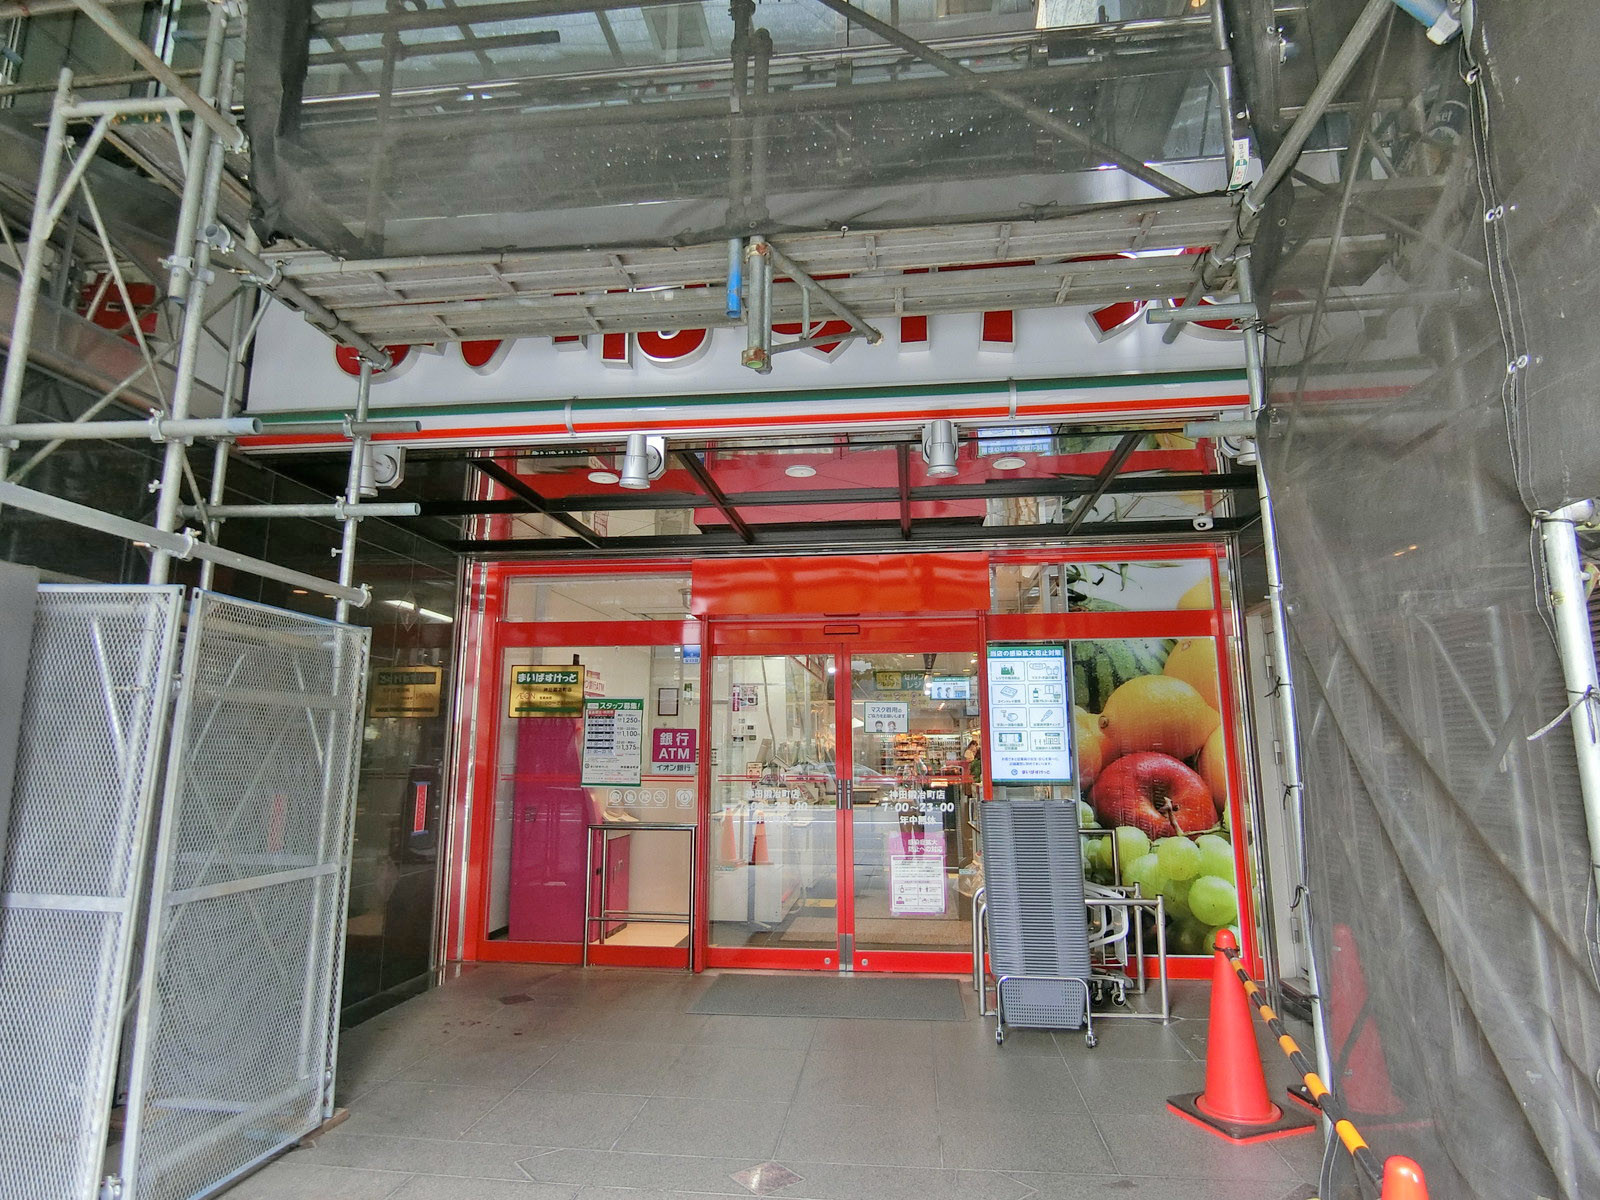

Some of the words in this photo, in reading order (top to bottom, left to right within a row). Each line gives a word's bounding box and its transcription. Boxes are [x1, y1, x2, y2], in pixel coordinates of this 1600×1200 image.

[518, 673, 577, 682] まいばすけっと
[904, 673, 925, 681] セルフ
[907, 681, 922, 689] レジ
[660, 732, 689, 746] 銀行
[659, 748, 690, 760] ATM
[656, 763, 691, 772] イオン銀行
[889, 790, 946, 800] 神田鍛冶町店
[900, 815, 937, 825] 年中無休
